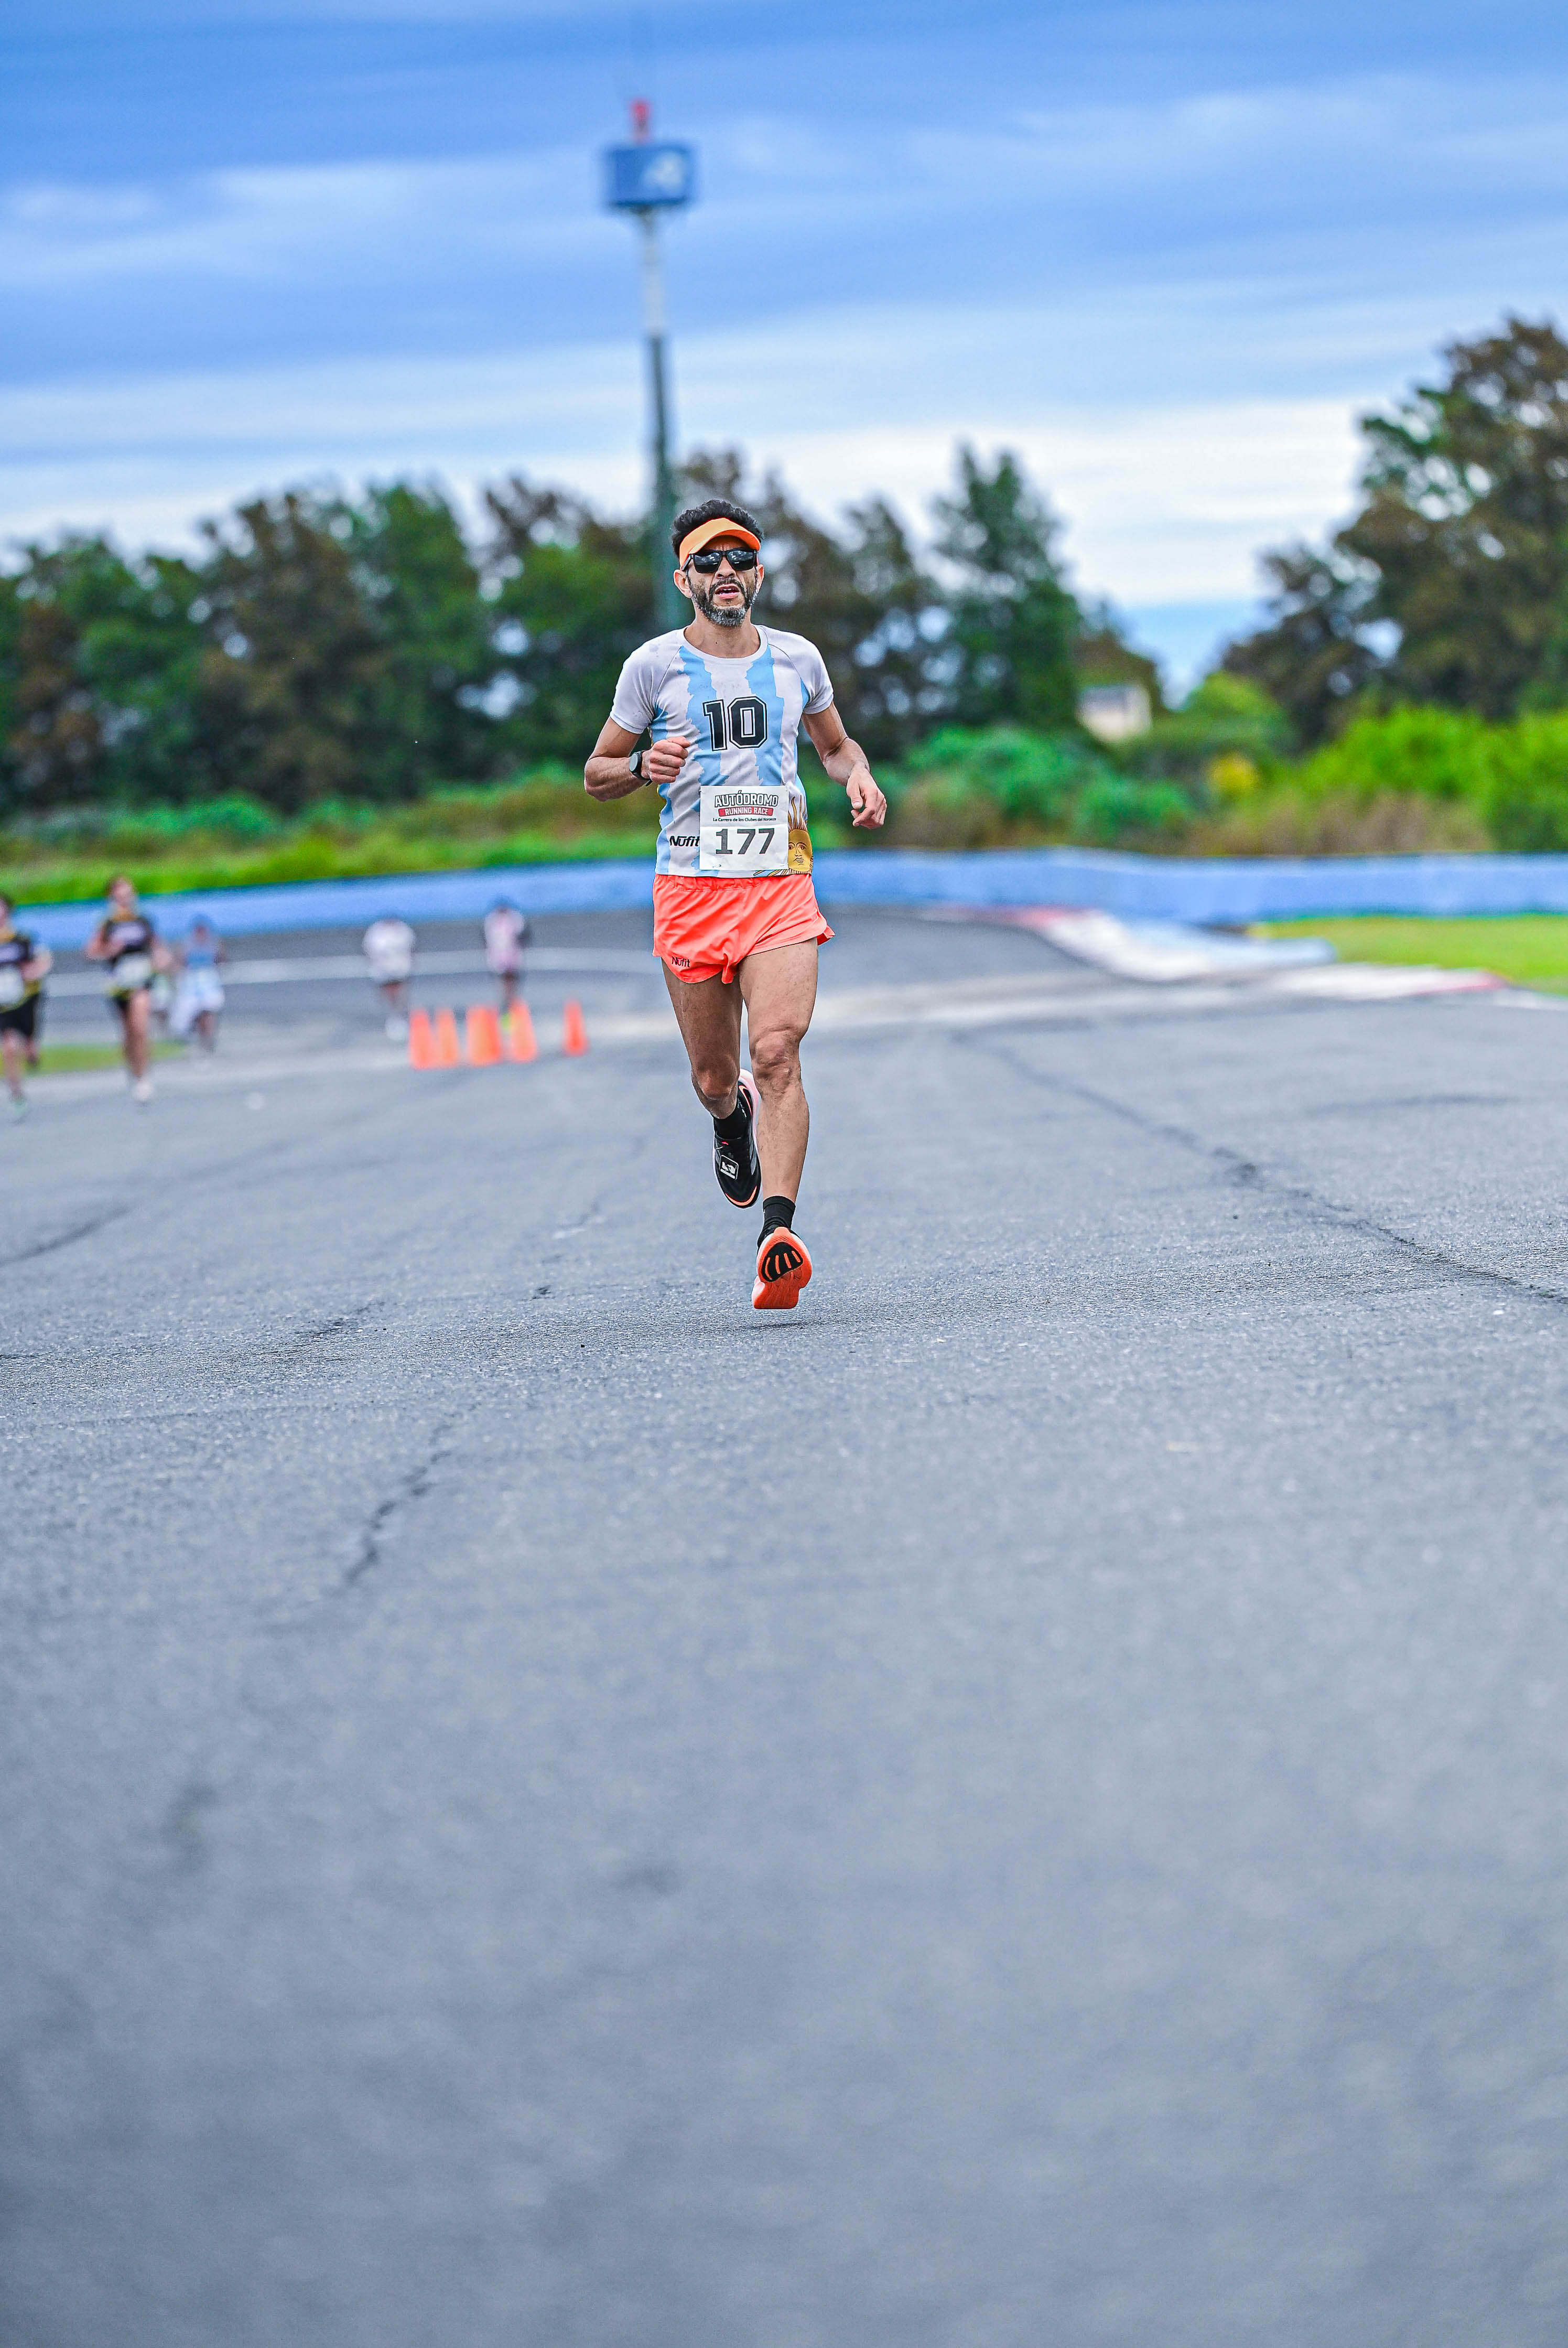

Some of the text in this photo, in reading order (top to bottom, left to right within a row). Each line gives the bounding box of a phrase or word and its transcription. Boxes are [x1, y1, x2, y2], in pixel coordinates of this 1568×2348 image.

[702, 696, 767, 751] 10
[715, 790, 778, 807] AUTÓDROMO
[724, 806, 752, 816] RUNNING
[716, 828, 775, 855] 177
